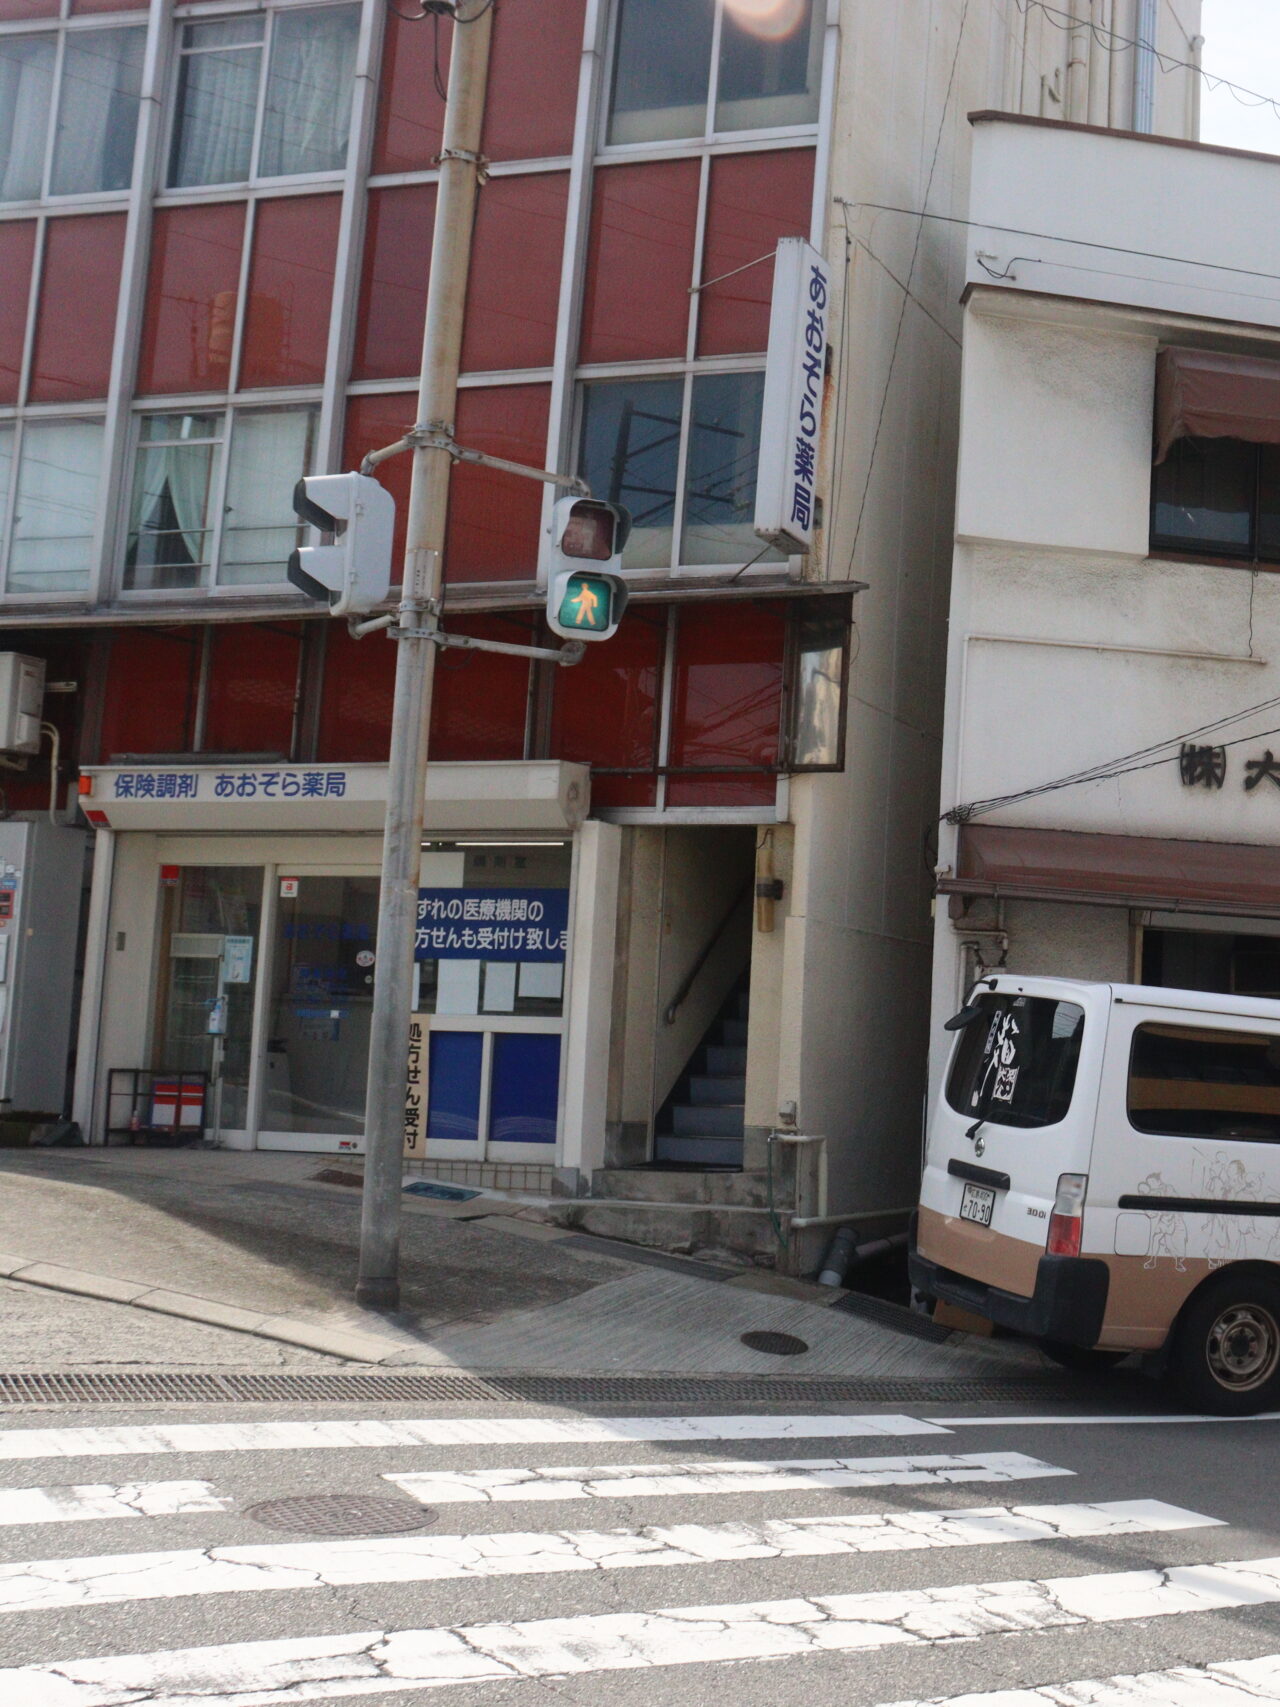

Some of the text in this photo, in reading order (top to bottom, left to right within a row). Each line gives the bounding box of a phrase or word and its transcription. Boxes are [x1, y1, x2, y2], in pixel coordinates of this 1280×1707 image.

[791, 265, 827, 531] あおぞら薬局
[114, 774, 199, 798] 保険調剤
[215, 772, 346, 797] あおぞら薬局
[417, 898, 544, 921] ずれの医療機関の
